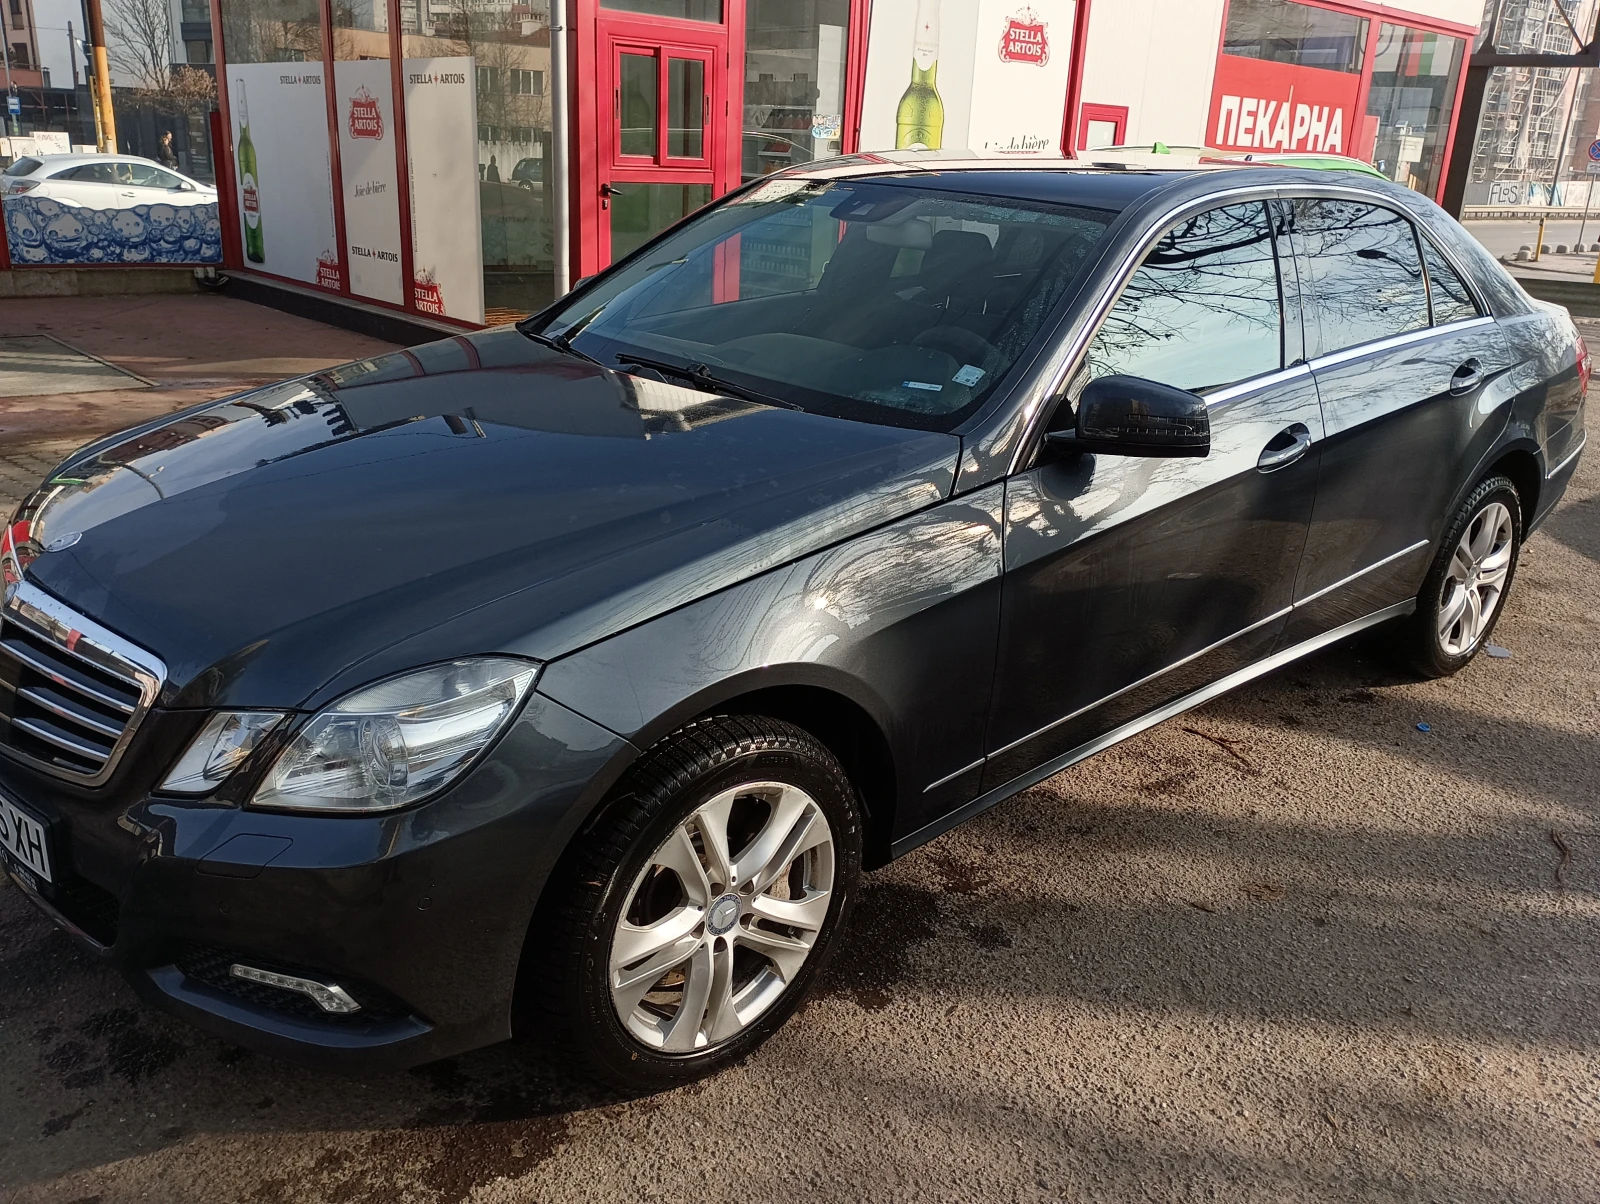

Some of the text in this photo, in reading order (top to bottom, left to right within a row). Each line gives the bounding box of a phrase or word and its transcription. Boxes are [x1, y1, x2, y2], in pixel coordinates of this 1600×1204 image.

[1009, 27, 1043, 43] STELLA
[1007, 41, 1043, 56] ARTOIS
[280, 75, 321, 85] STELLA ARTOIS
[409, 73, 466, 84] STELLA ARTOIS
[353, 107, 377, 118] STELLA
[354, 118, 378, 130] ARTOIS
[1215, 94, 1343, 153] ПЕКАРНА
[365, 181, 373, 196] de
[351, 245, 399, 263] STELLA ARTOIS
[320, 267, 340, 279] STELLA
[321, 277, 341, 291] ARTOIS
[414, 287, 438, 303] STELLA
[414, 299, 440, 315] ARTOIS
[9, 807, 46, 873] XH
